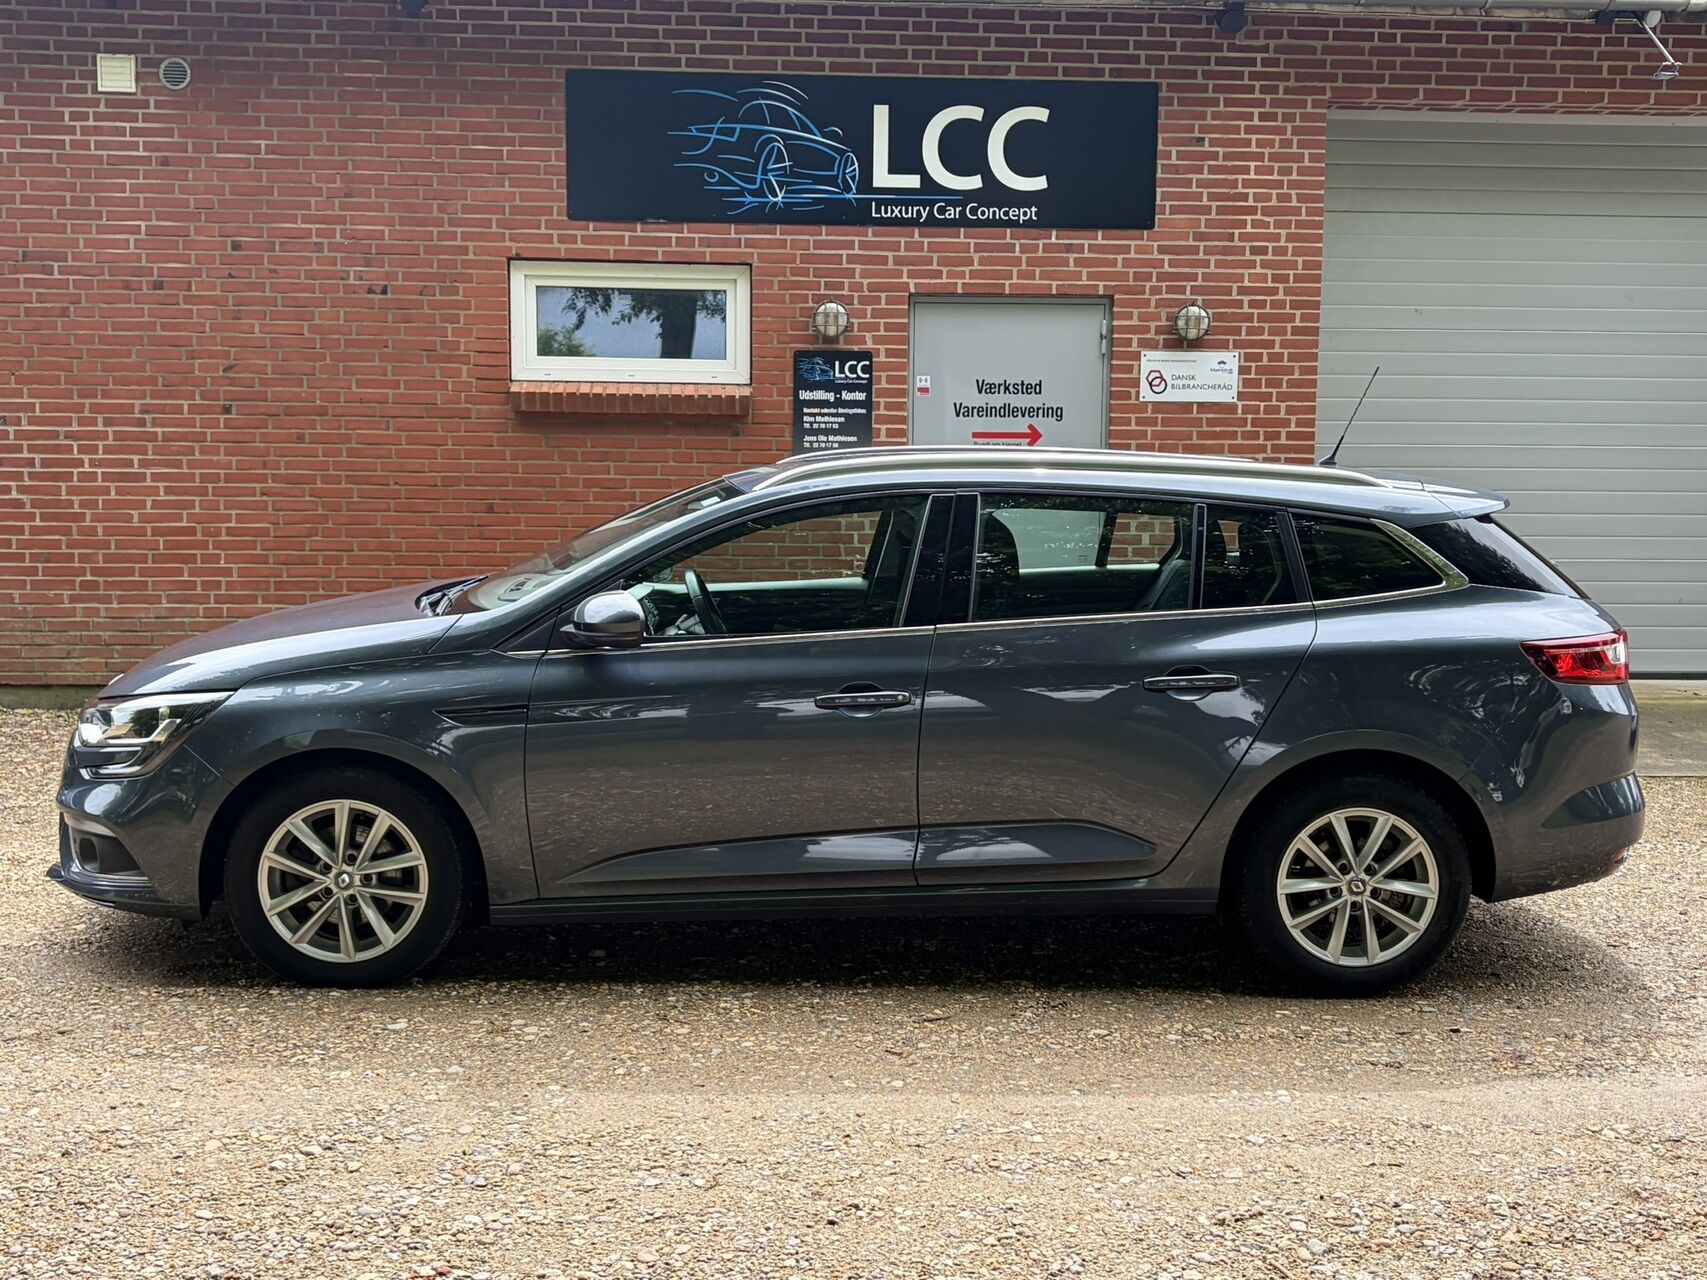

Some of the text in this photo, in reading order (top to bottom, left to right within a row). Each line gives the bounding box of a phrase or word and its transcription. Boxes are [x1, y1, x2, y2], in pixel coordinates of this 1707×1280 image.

[872, 104, 1050, 192] LCC
[871, 201, 1038, 223] Luxury Car Concept
[834, 360, 870, 378] LCC
[799, 389, 835, 402] Udstilling
[841, 390, 867, 400] Kontor
[975, 379, 1042, 395] Værksted
[1170, 382, 1233, 391] BILBRANCHERÅD
[953, 402, 1063, 422] Vareindlevering
